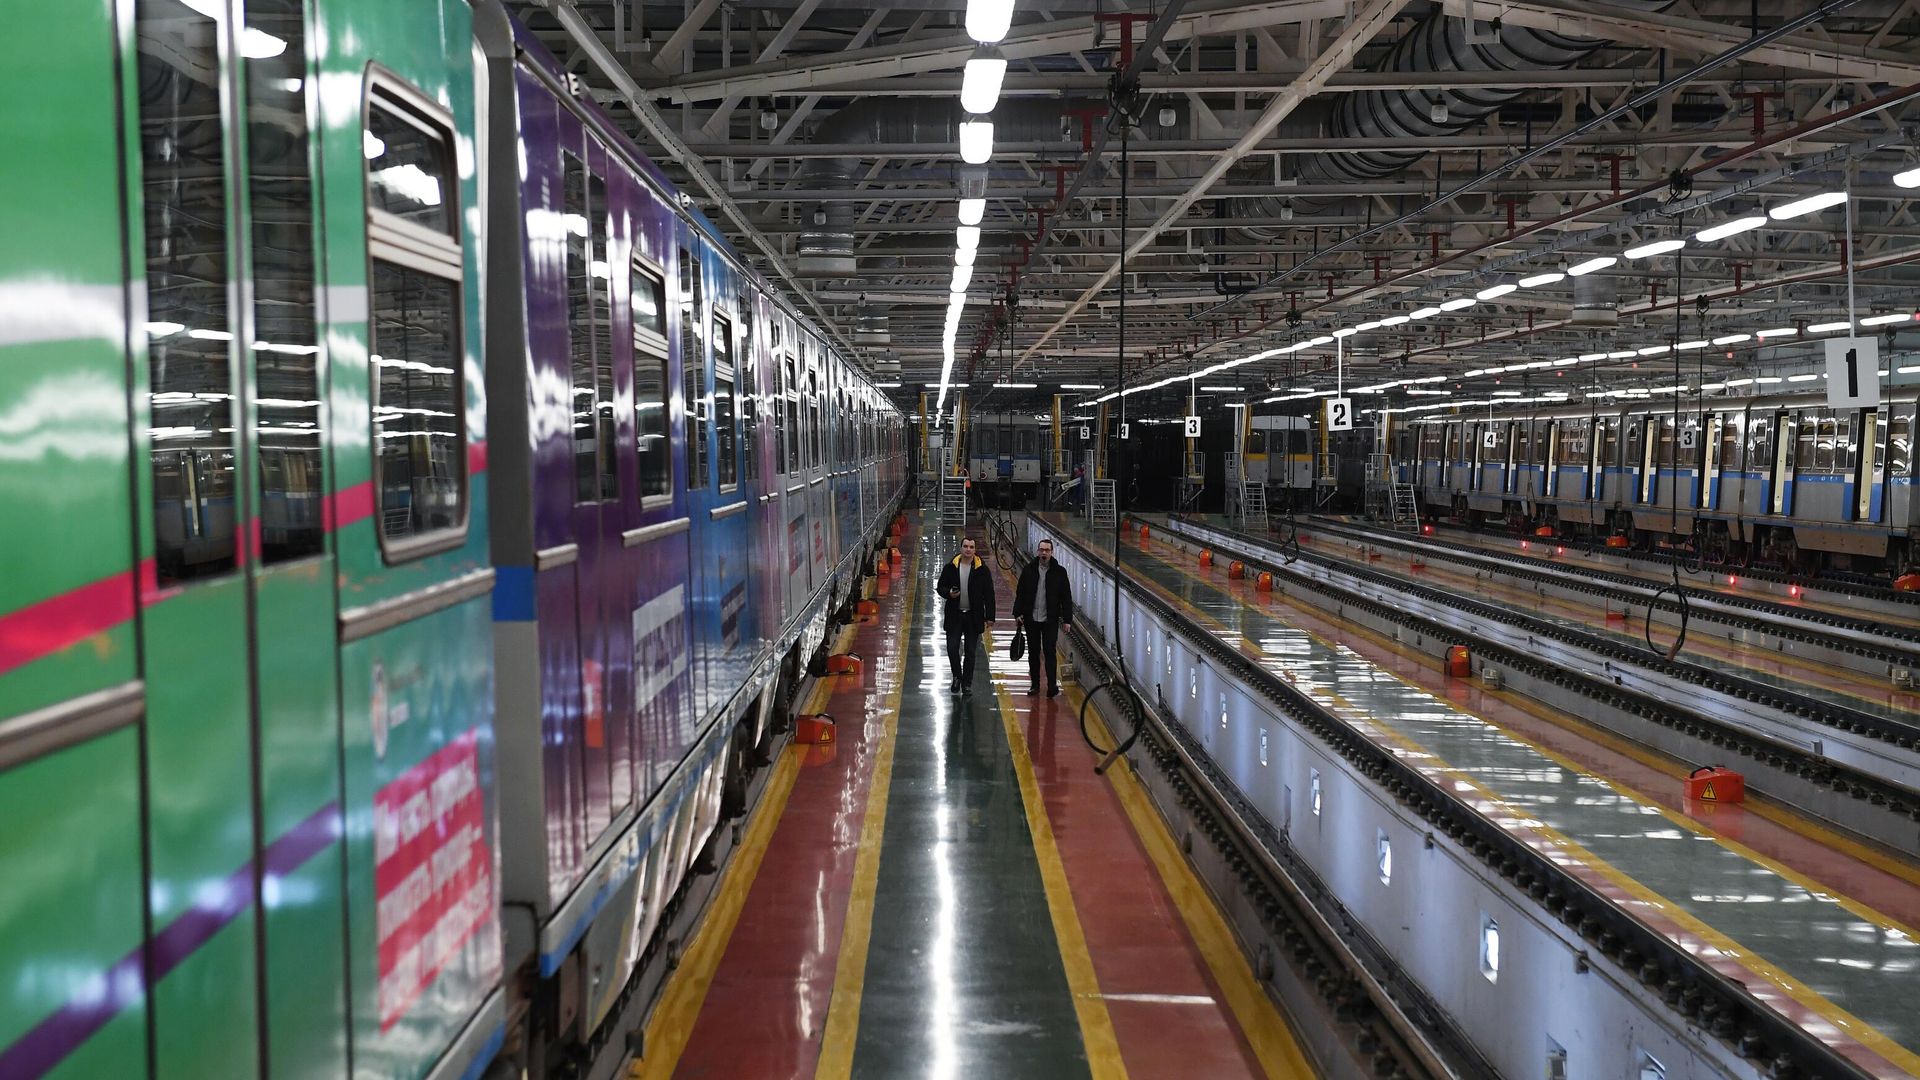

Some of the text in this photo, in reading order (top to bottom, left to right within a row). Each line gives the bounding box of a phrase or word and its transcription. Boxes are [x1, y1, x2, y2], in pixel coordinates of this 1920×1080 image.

[1845, 348, 1859, 398] 1
[1333, 403, 1347, 426] 2
[1082, 428, 1088, 438] 5
[1189, 419, 1197, 434] 3
[1487, 434, 1494, 446] 4
[1683, 430, 1693, 446] 3
